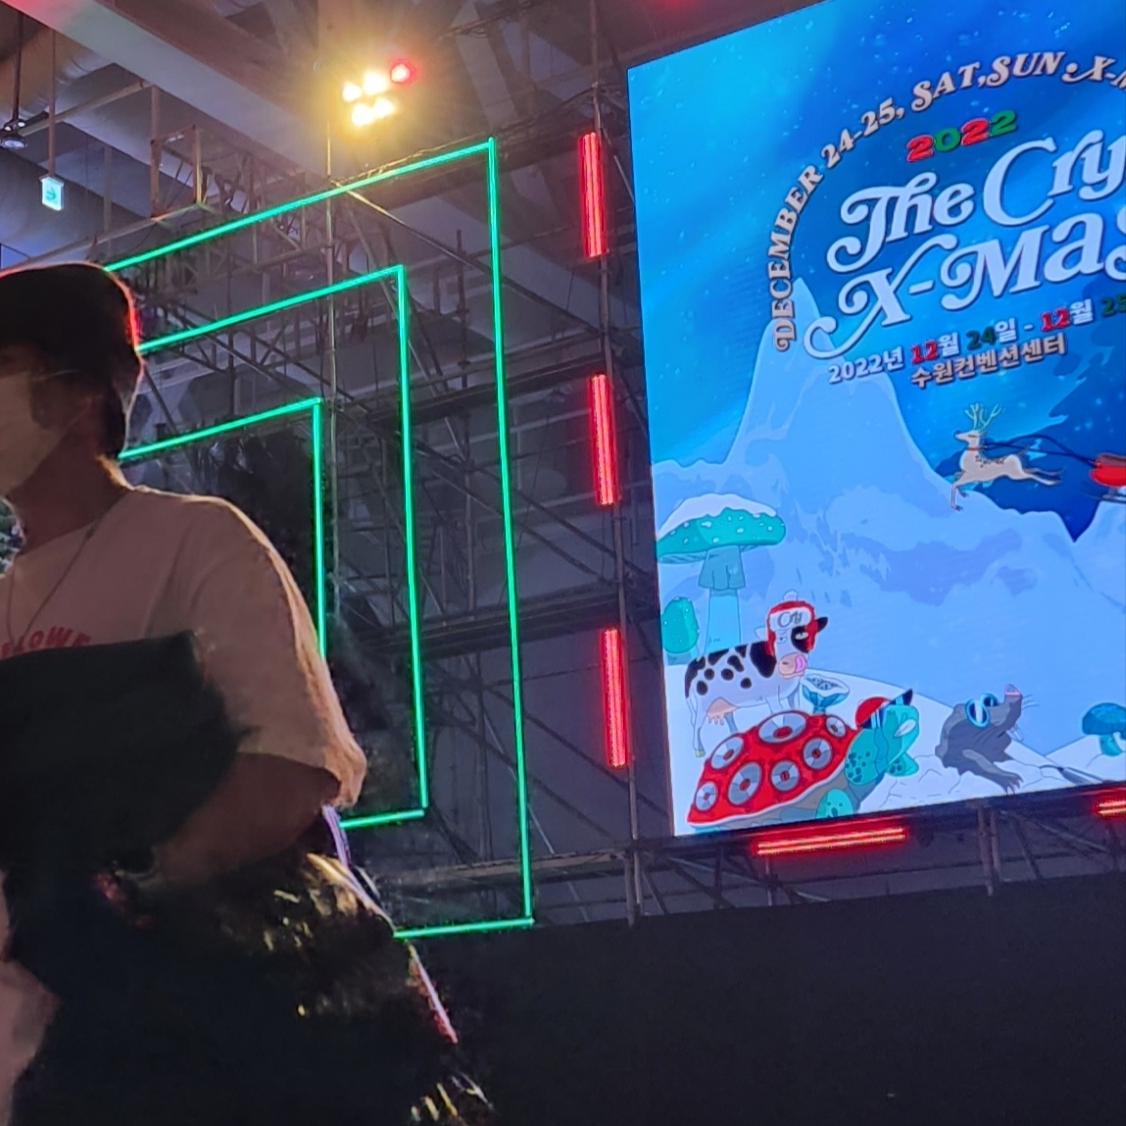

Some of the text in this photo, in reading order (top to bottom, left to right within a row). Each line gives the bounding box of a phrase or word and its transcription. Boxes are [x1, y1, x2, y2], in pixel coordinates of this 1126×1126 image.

[905, 109, 1018, 162] 2022
[767, 164, 824, 352] DECEMBER
[820, 97, 906, 169] 24-25,
[826, 129, 1126, 274] The Cry
[827, 345, 907, 384] 2022년
[909, 331, 961, 364] 12월
[965, 317, 1018, 351] 24일
[1039, 298, 1095, 333] 12월
[909, 331, 1068, 389] 수원컨벤션센터
